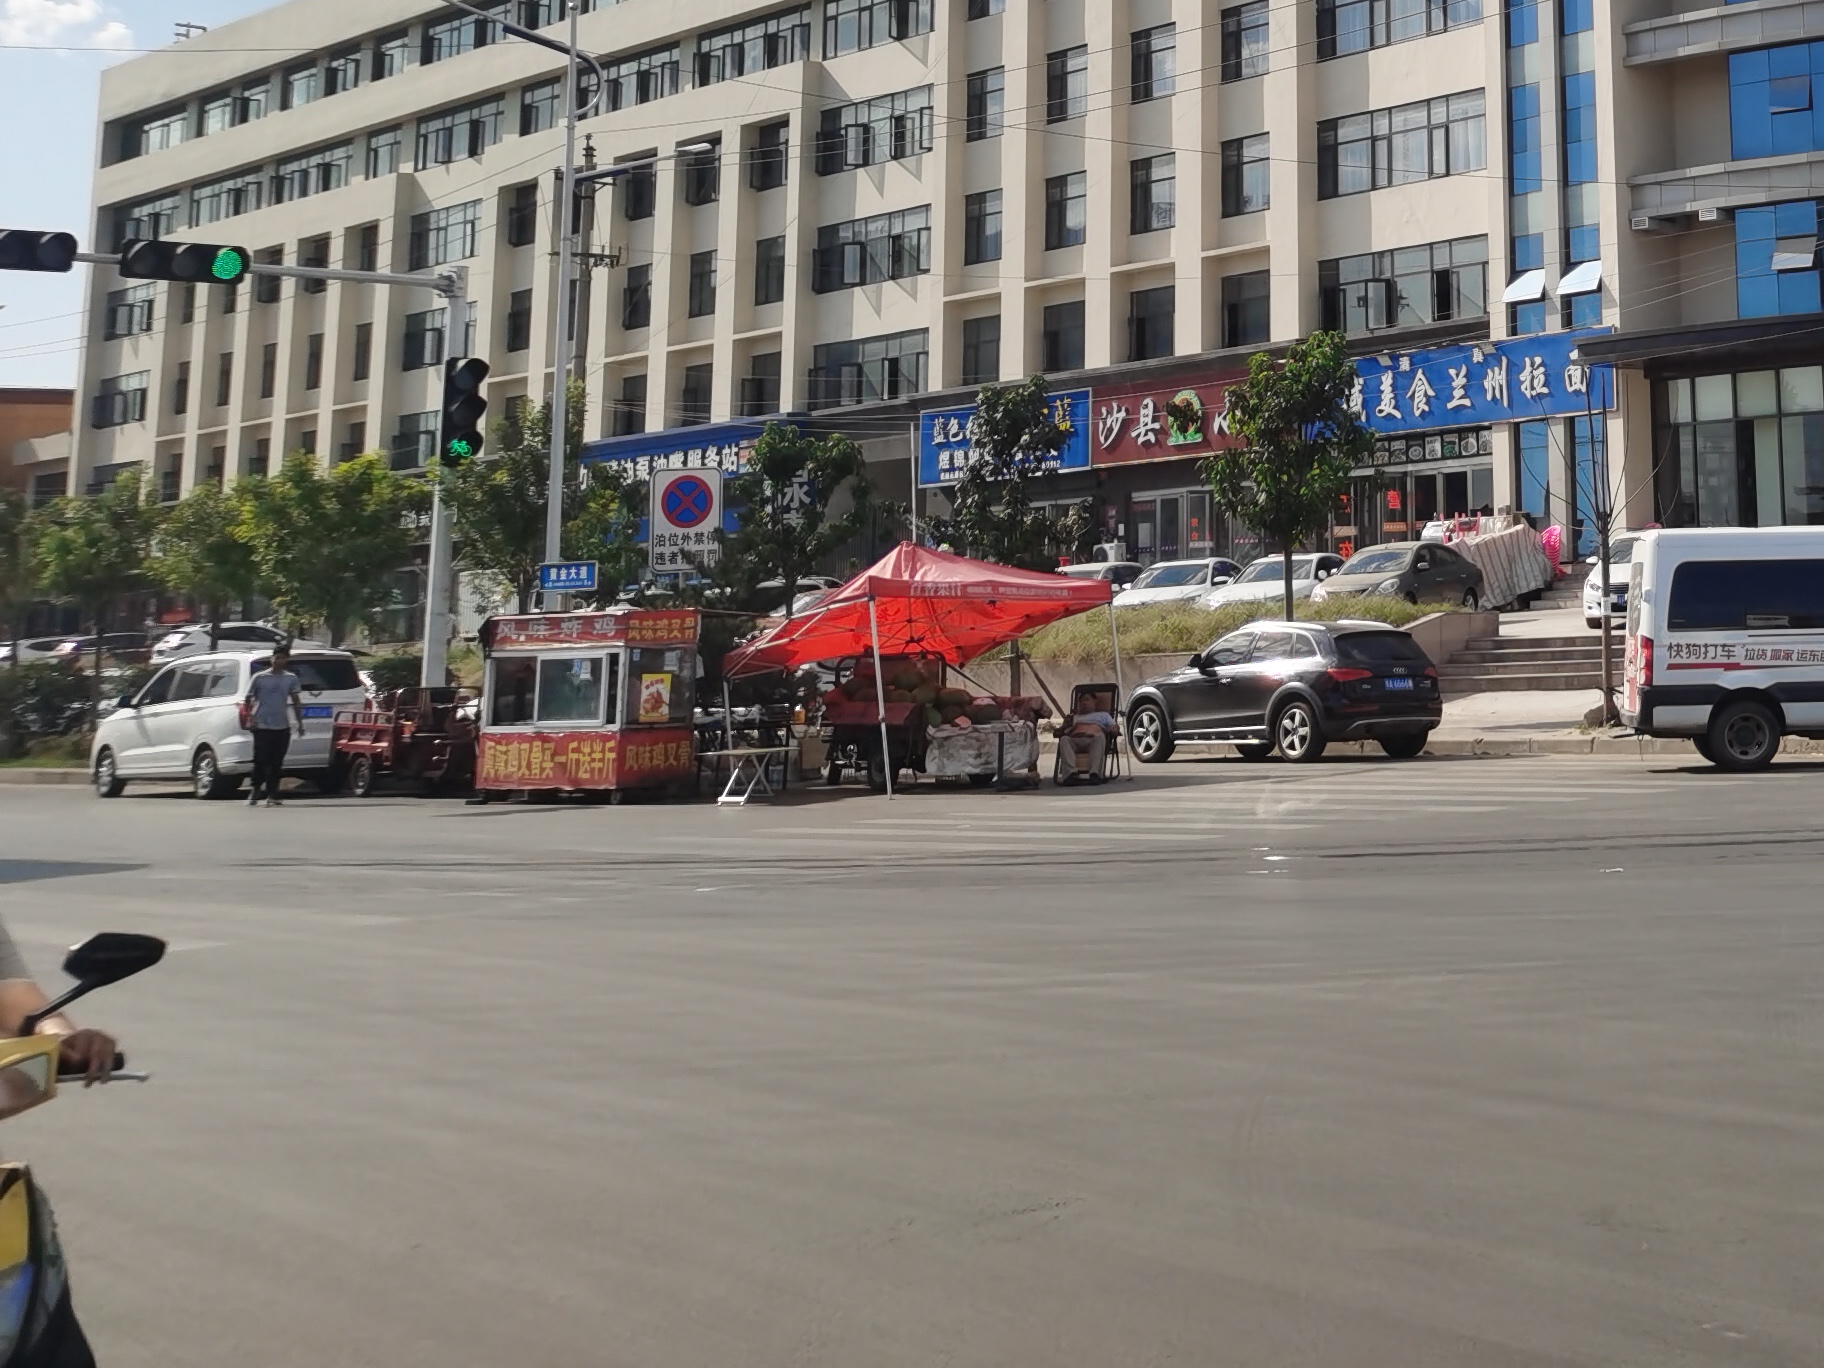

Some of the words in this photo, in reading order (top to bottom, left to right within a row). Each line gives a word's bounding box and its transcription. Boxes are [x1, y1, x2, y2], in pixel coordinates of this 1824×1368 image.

[549, 566, 588, 581] 黄金大道
[1667, 642, 1737, 661] 快狗打车
